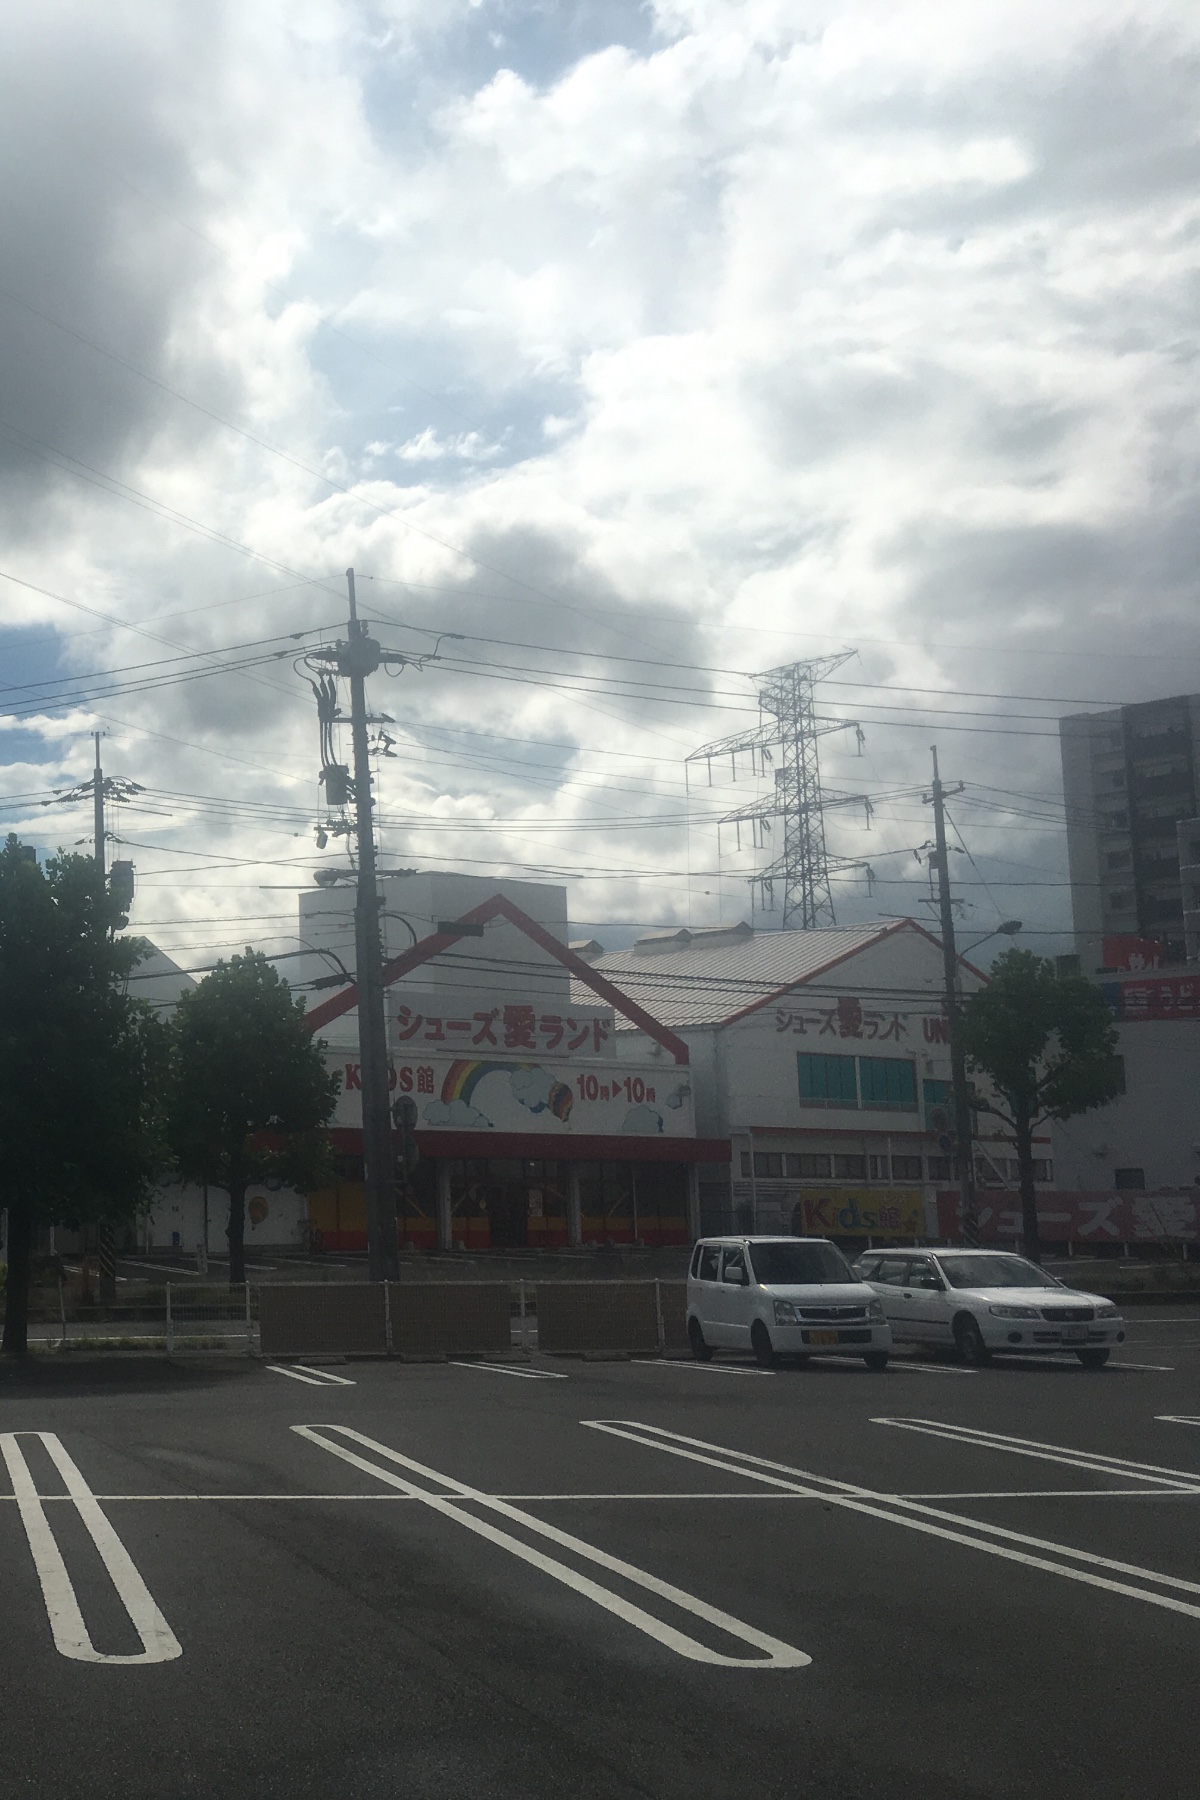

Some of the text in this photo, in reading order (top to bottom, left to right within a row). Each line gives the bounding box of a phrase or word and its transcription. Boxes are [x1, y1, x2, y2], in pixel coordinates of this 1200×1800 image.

[396, 1004, 611, 1053] シューズ愛ランド
[775, 997, 908, 1042] シューズ愛ランド
[345, 1063, 434, 1095] KDS館
[803, 1197, 902, 1229] Kids館
